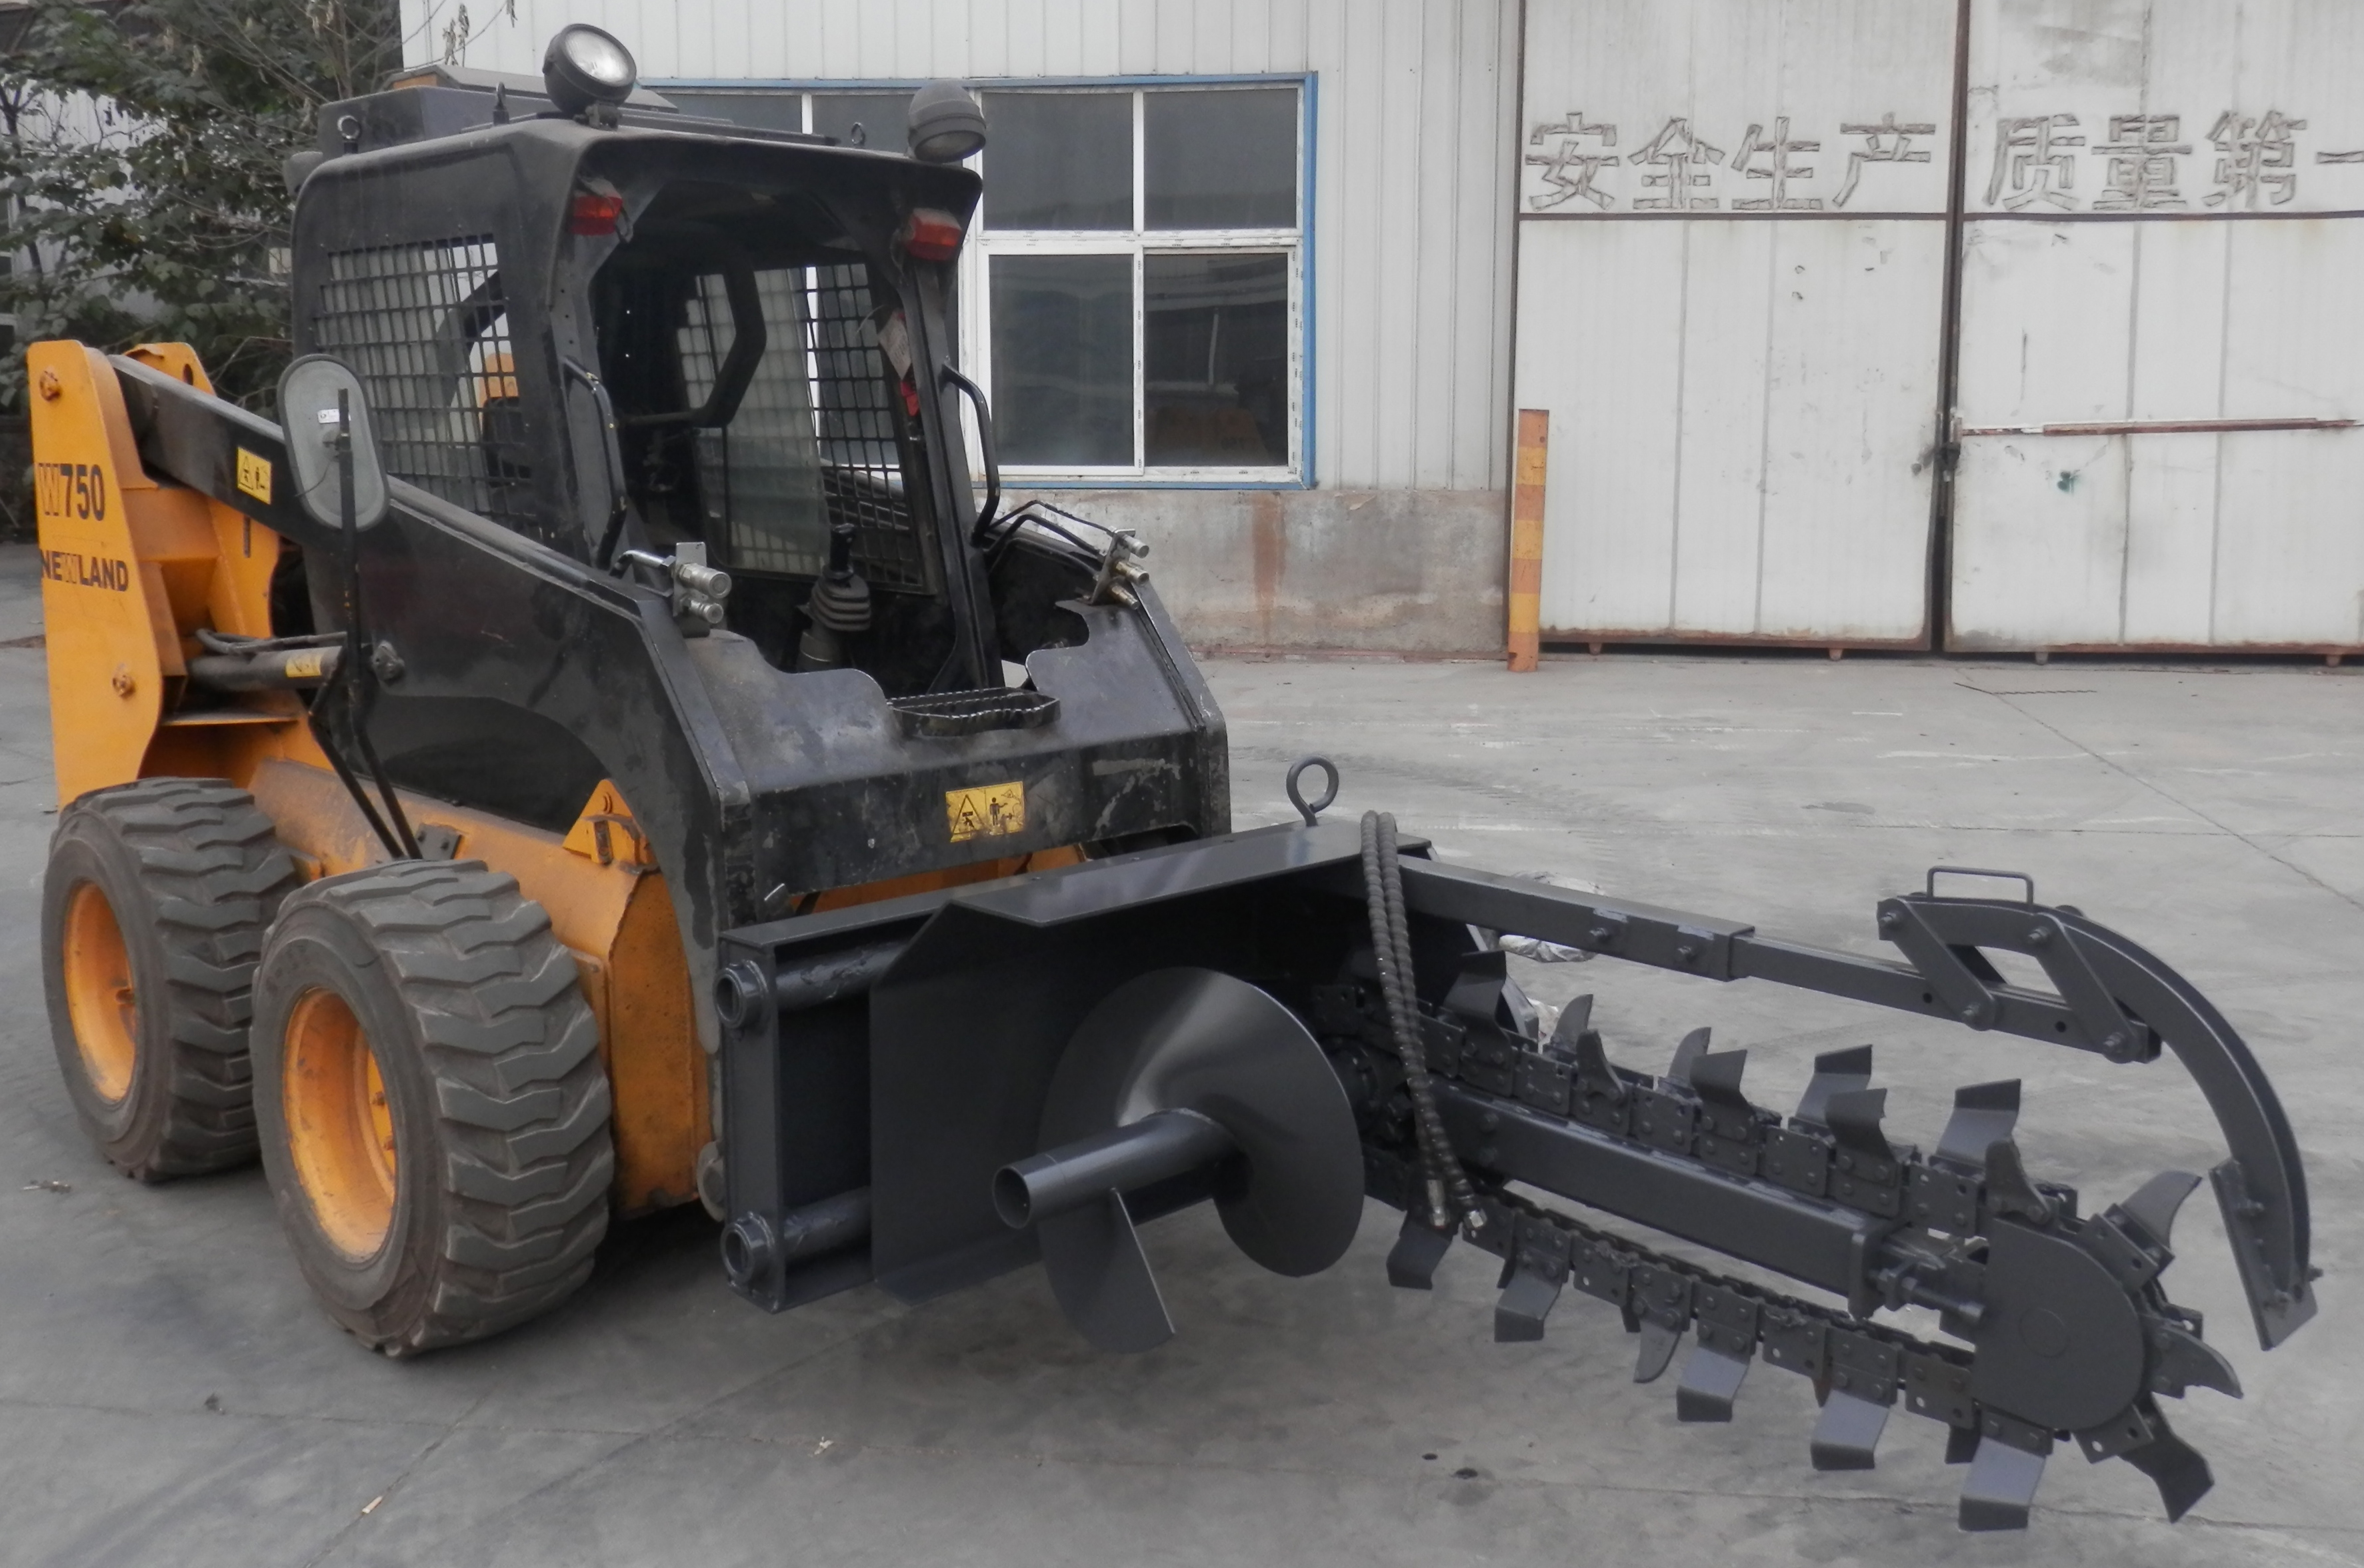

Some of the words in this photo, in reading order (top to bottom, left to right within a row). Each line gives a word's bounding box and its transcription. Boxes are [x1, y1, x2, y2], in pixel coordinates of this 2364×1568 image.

[1525, 112, 1936, 211] 安全生产
[38, 463, 105, 521] W750
[41, 550, 129, 592] NEWLAND
